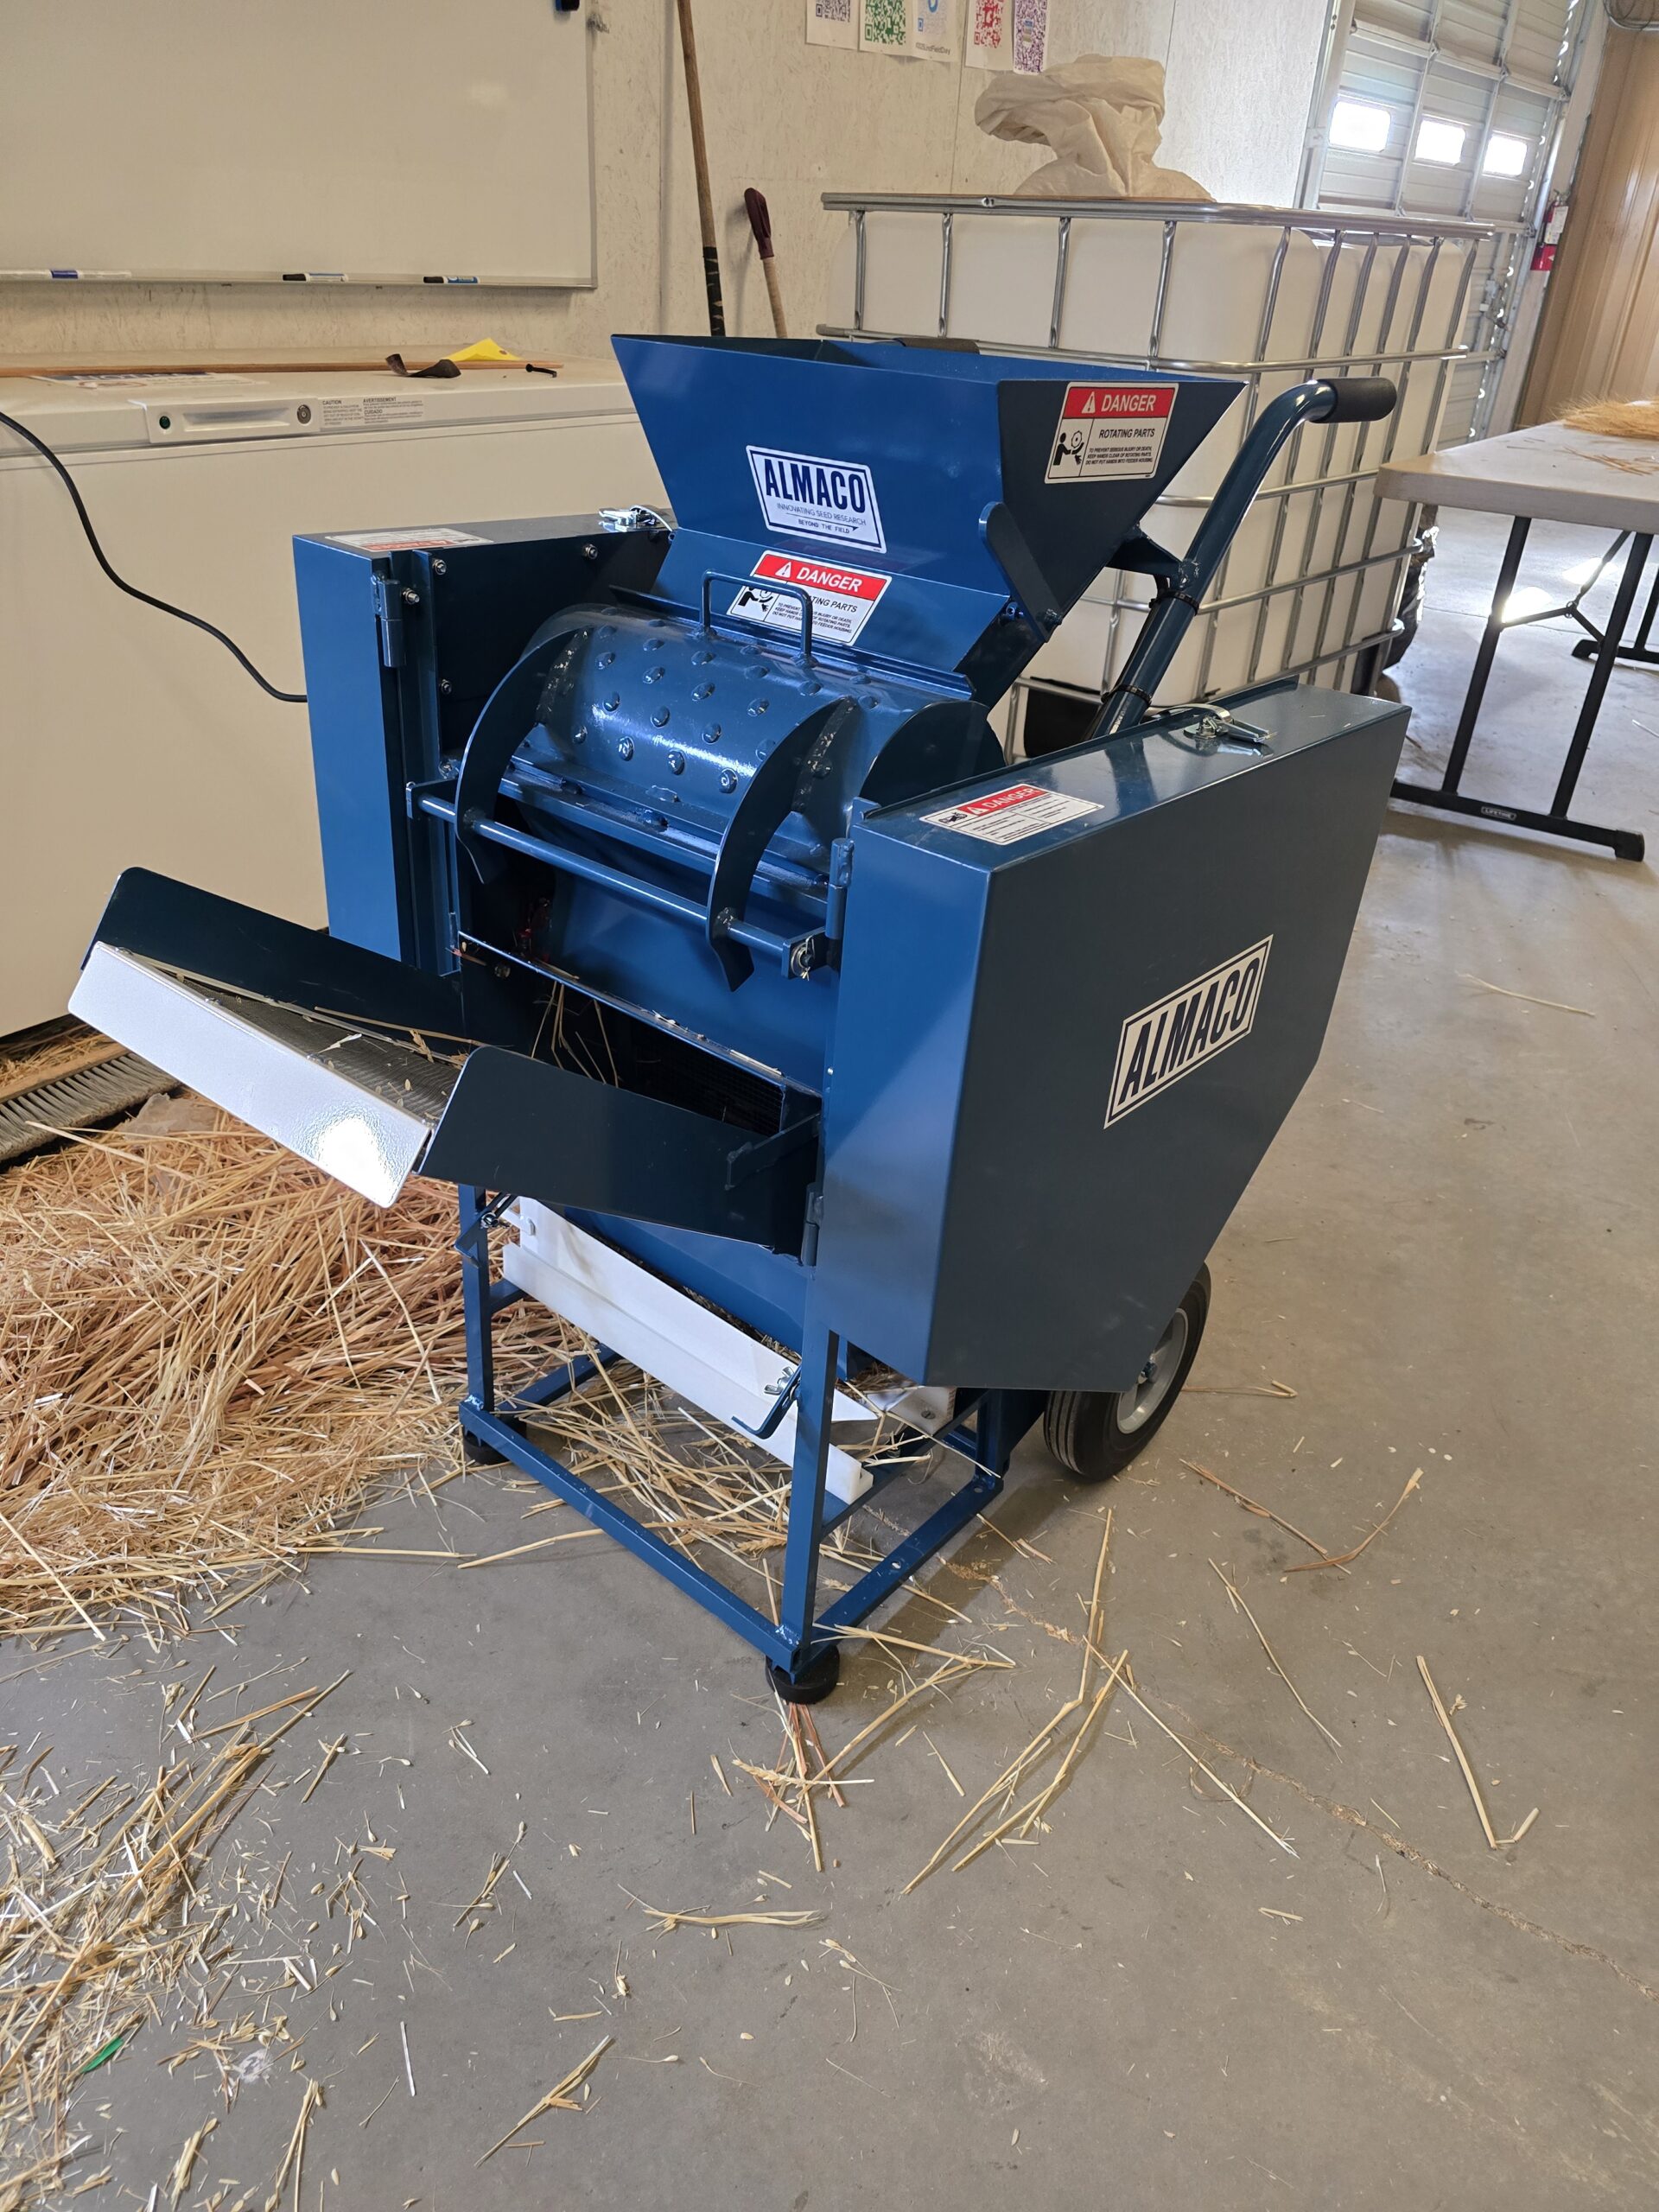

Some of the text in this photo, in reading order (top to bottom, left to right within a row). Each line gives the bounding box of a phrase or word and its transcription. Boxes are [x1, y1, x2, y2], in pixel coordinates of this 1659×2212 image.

[1101, 394, 1157, 412] DANGER
[1099, 428, 1155, 439] ROTATING PARTS
[764, 458, 866, 513] ALMACO
[777, 503, 867, 525] INNOVATING SEED RESEARCH
[798, 519, 819, 528] BEYOND
[796, 567, 862, 593] DANGER
[811, 595, 858, 613] TING PARTS
[982, 787, 1040, 809] DANGER
[1117, 957, 1261, 1106] ALMACO
